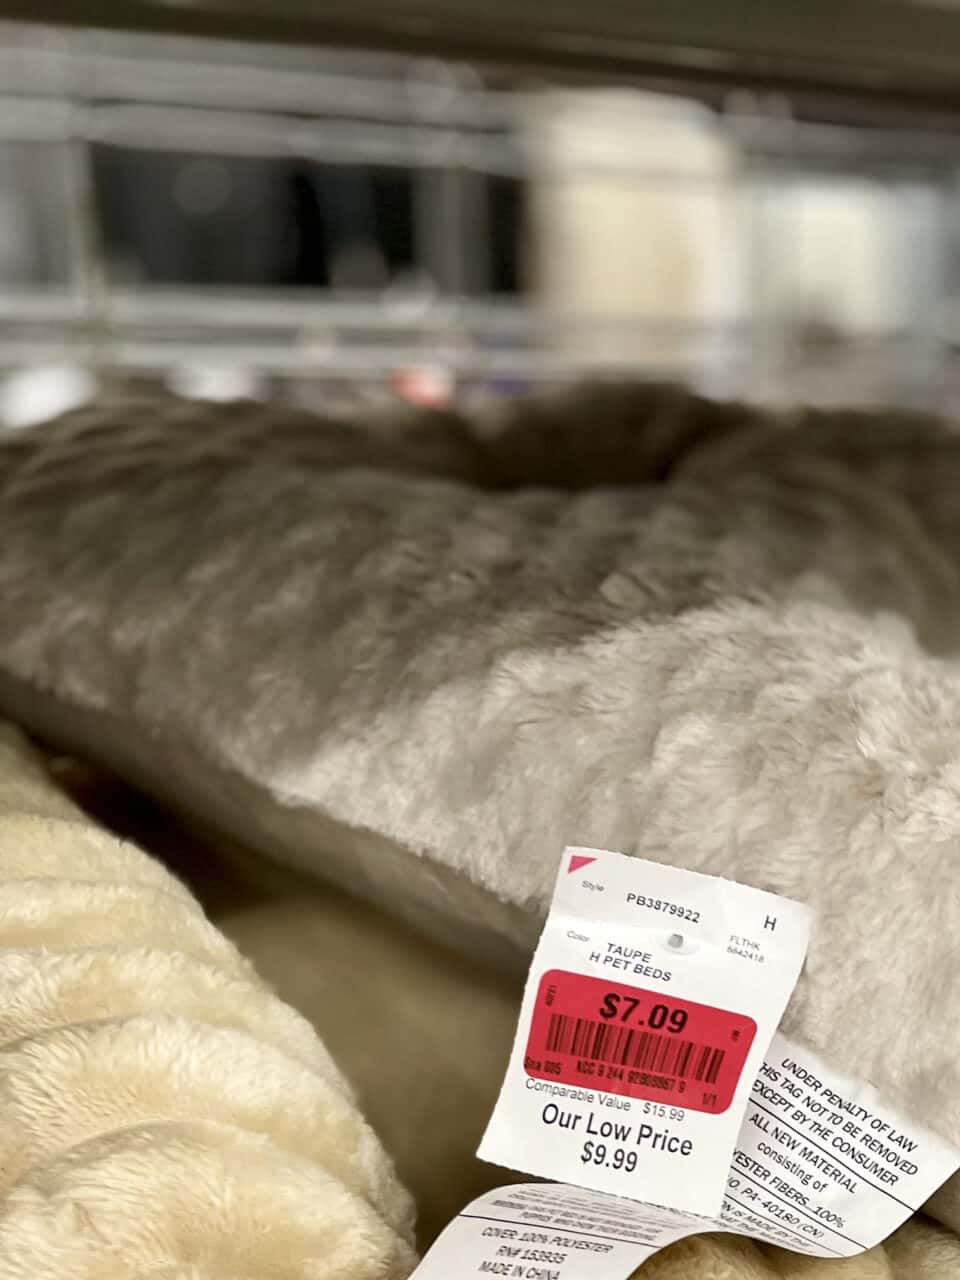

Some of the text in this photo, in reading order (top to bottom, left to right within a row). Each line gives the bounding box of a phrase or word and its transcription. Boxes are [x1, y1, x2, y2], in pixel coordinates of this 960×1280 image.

[626, 892, 701, 924] PB3879922
[763, 915, 777, 931] H
[588, 951, 672, 982] H PET BEDS
[606, 942, 653, 963] TAUPE
[599, 993, 689, 1034] $7.09
[525, 1077, 685, 1122] Comparable Value $15.99
[759, 1062, 919, 1176] HIS TAG NOT TO BE REMOVED
[781, 1058, 918, 1153] UNDER PENALTY OF LAW
[541, 1103, 693, 1156] Our Low Price
[751, 1080, 900, 1187] EXCEPT BY THE CONSUMER
[580, 1140, 638, 1173] $9.99
[749, 1113, 858, 1194] ALL NEW MATERIAL
[757, 1142, 829, 1193] consisting of
[478, 1260, 510, 1276] MADE
[511, 1264, 524, 1277] IN
